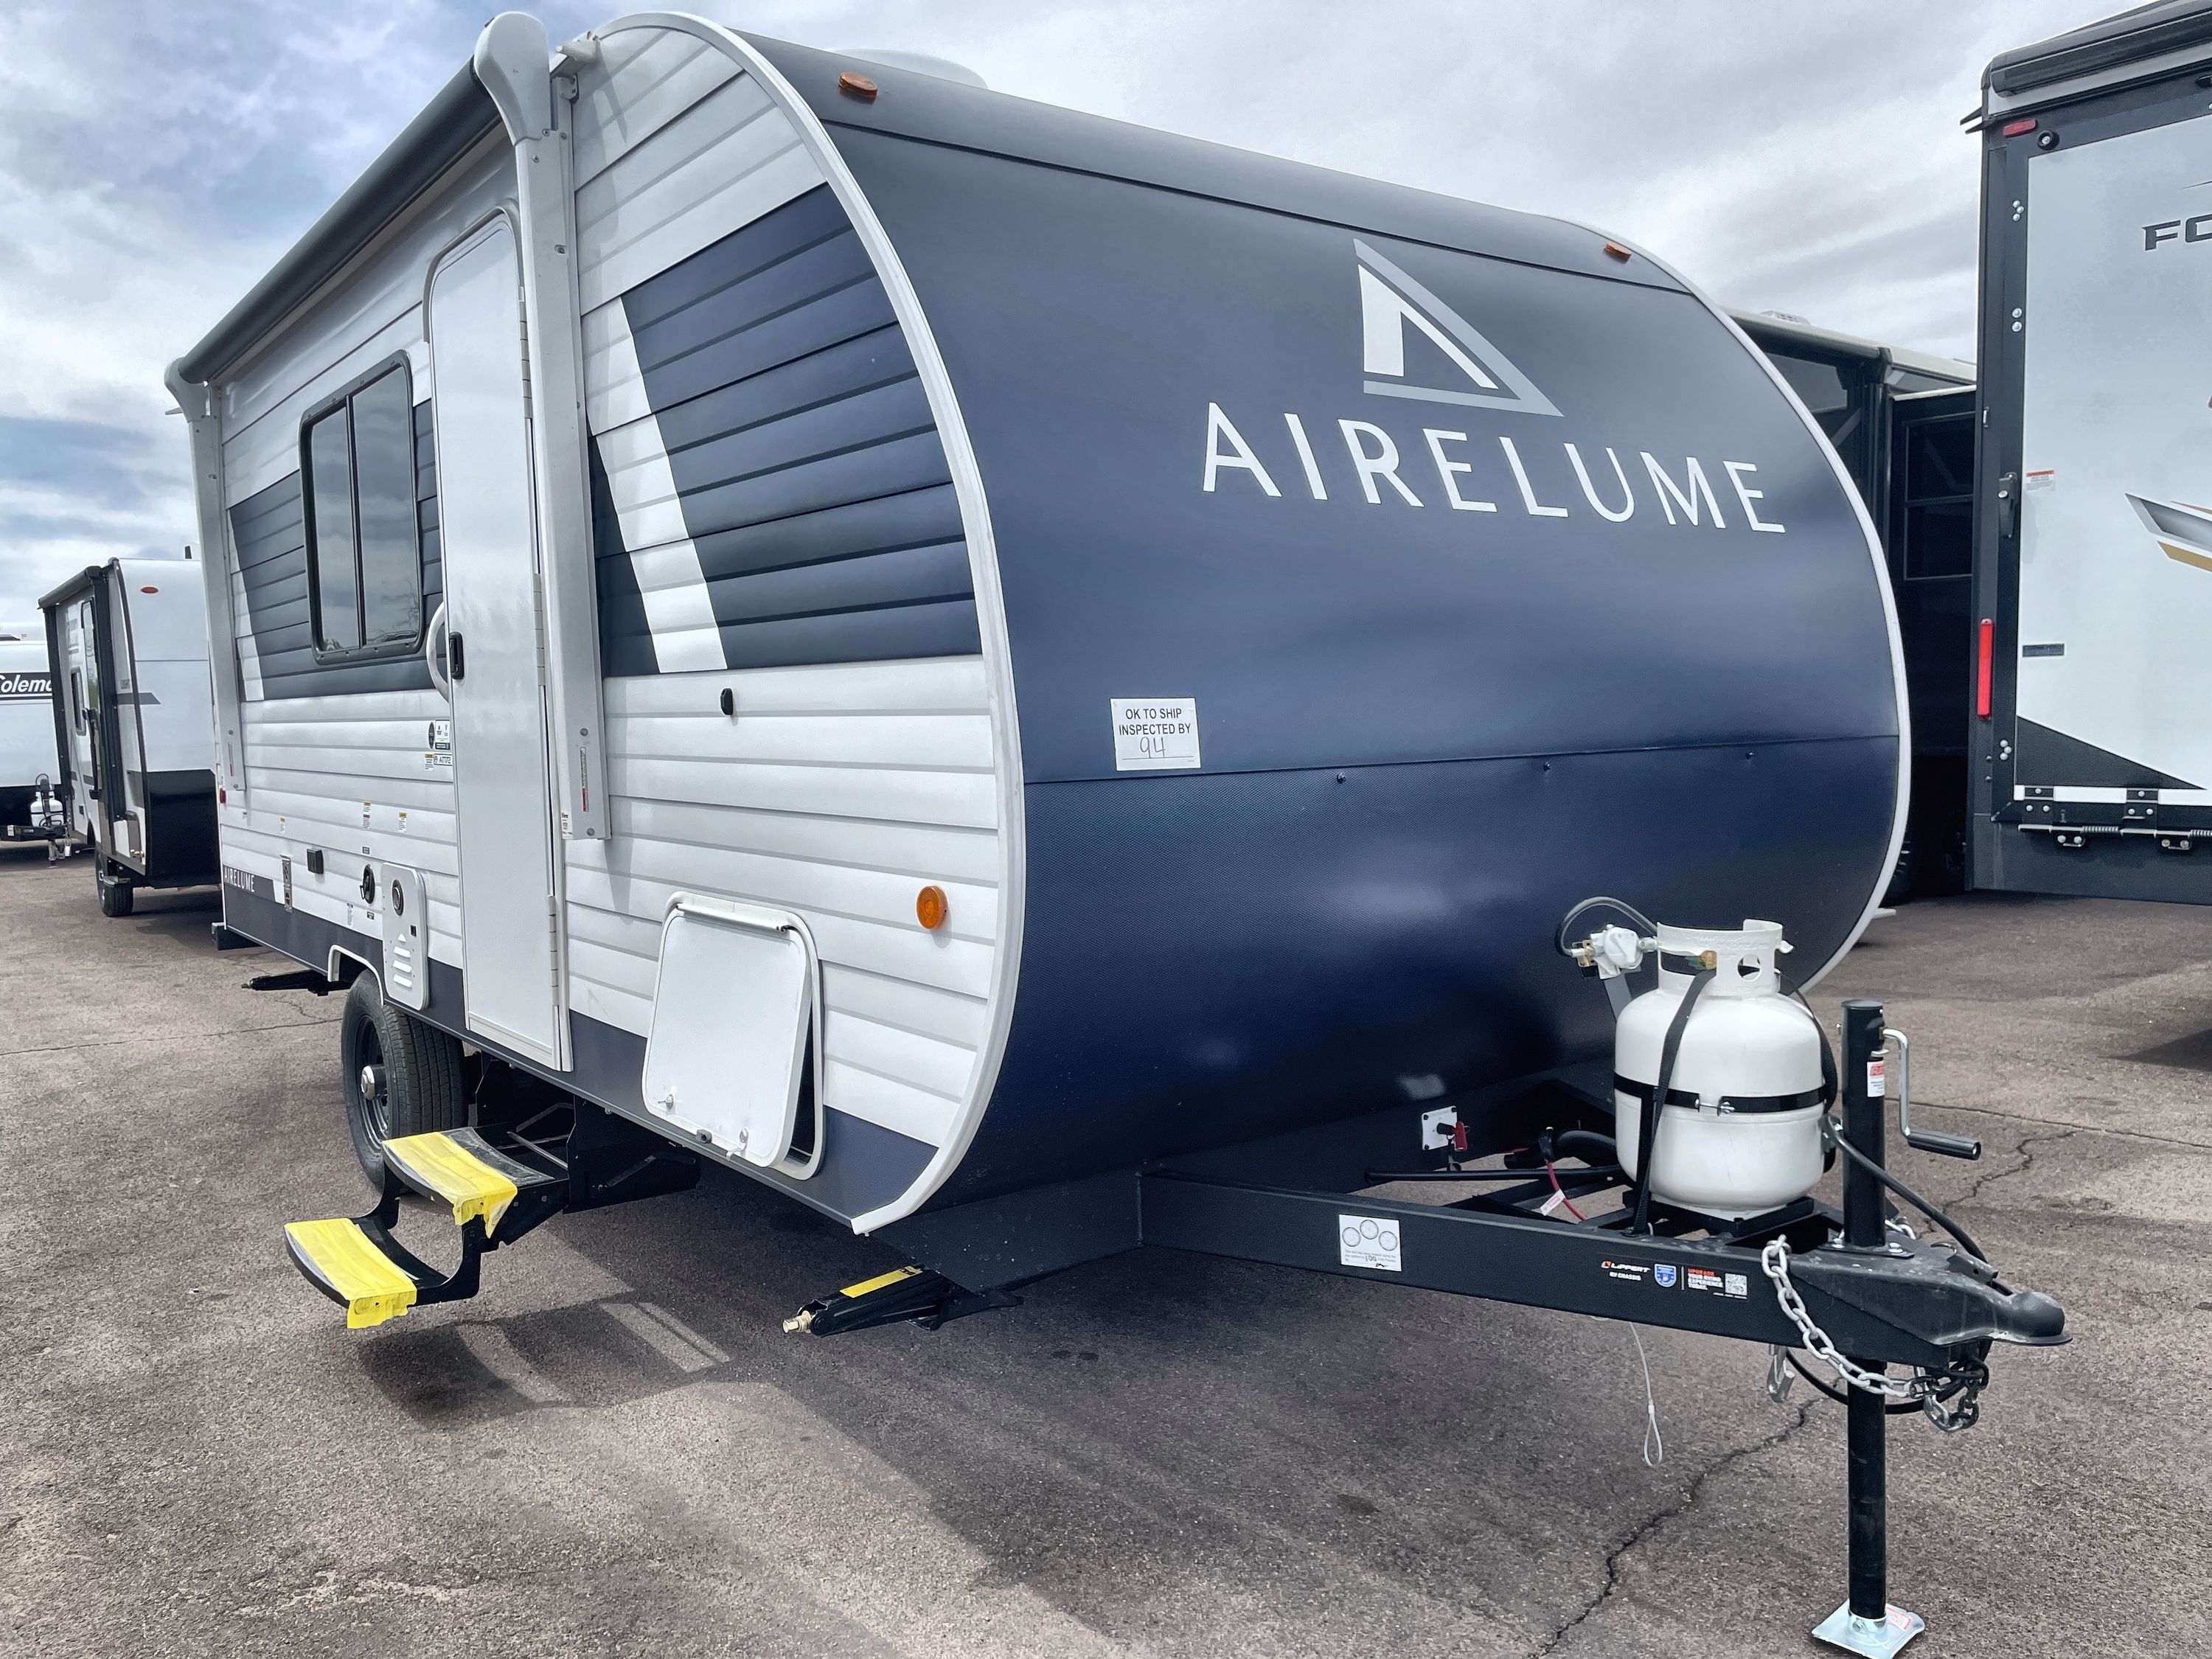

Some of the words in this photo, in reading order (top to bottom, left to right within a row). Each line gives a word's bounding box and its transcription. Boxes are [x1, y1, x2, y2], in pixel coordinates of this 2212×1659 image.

[1203, 402, 1786, 534] AIRELUME
[1125, 709, 1141, 720] OK
[1143, 708, 1157, 719] TO
[1160, 708, 1182, 719] SHIP
[1119, 723, 1175, 736] INSPECTED
[1178, 723, 1192, 734] BY
[1139, 736, 1166, 759] 94
[223, 866, 255, 893] AIRELUME
